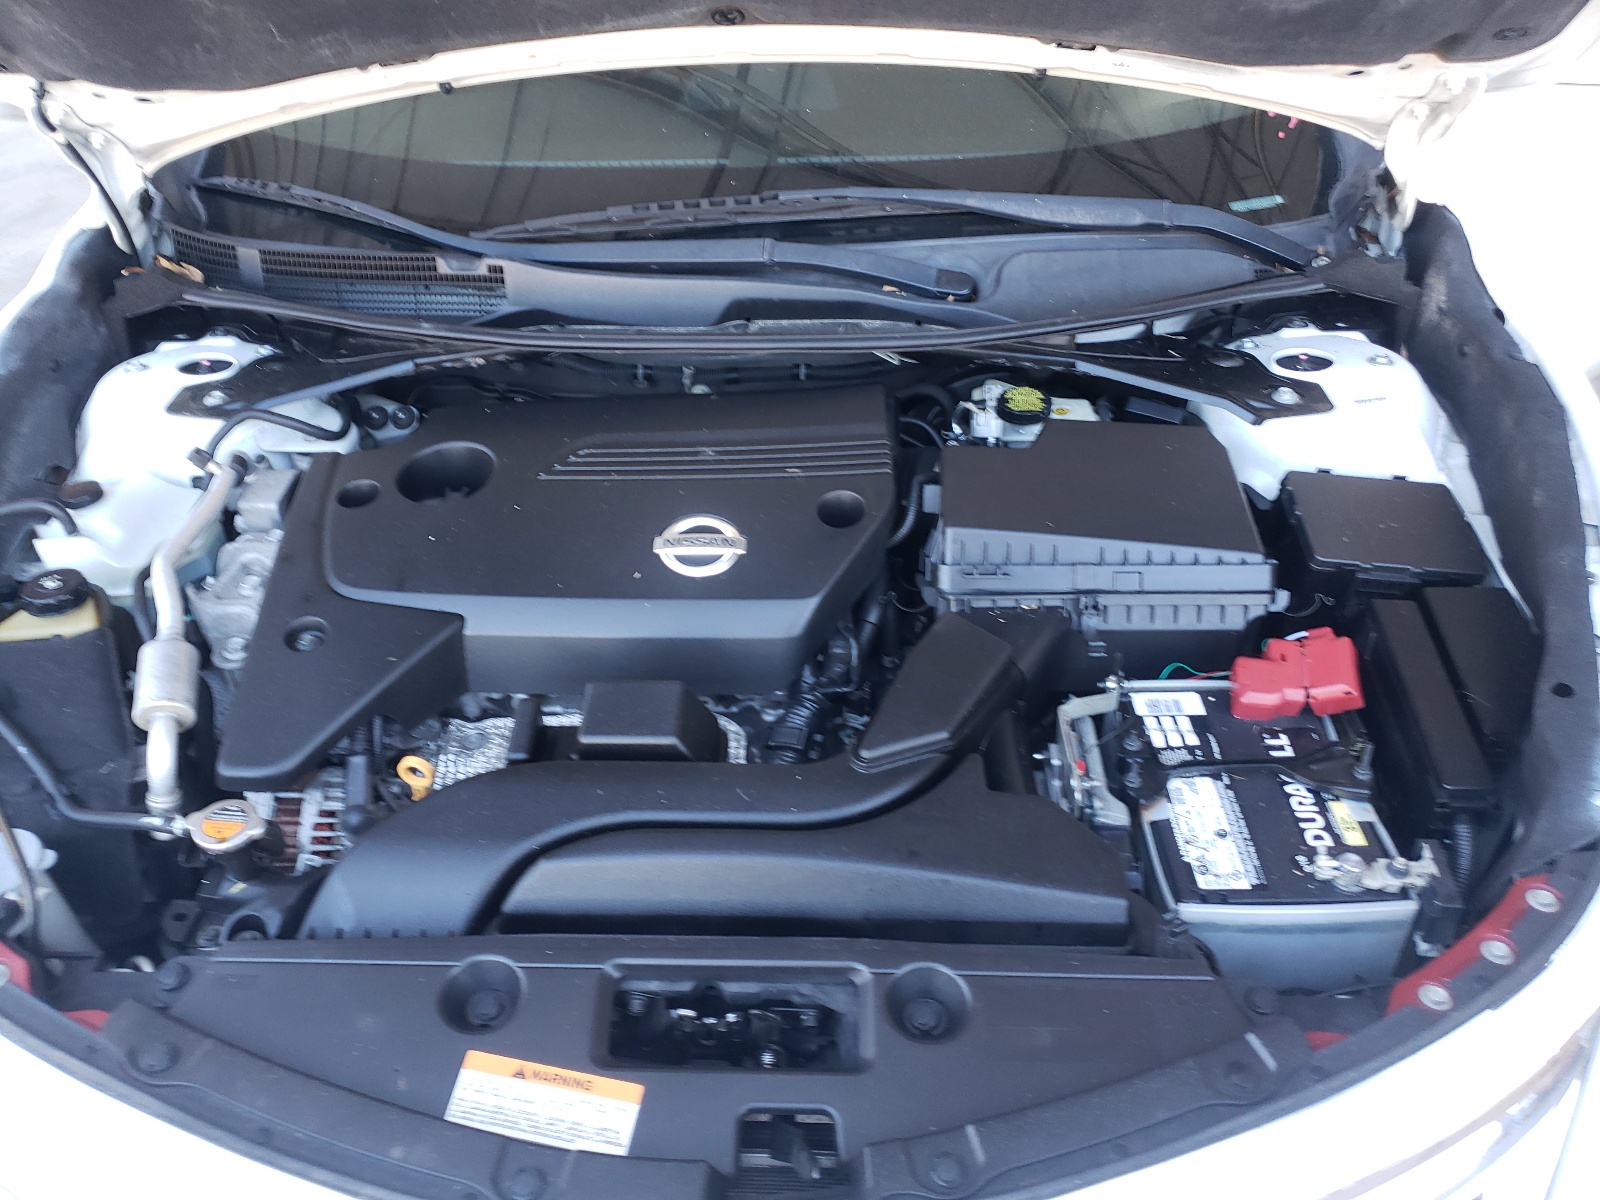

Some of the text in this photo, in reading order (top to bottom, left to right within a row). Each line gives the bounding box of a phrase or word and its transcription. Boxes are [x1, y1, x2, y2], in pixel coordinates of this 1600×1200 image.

[663, 537, 737, 547] NISSAN
[1264, 732, 1336, 847] DURALL
[531, 1069, 595, 1092] WARNING
